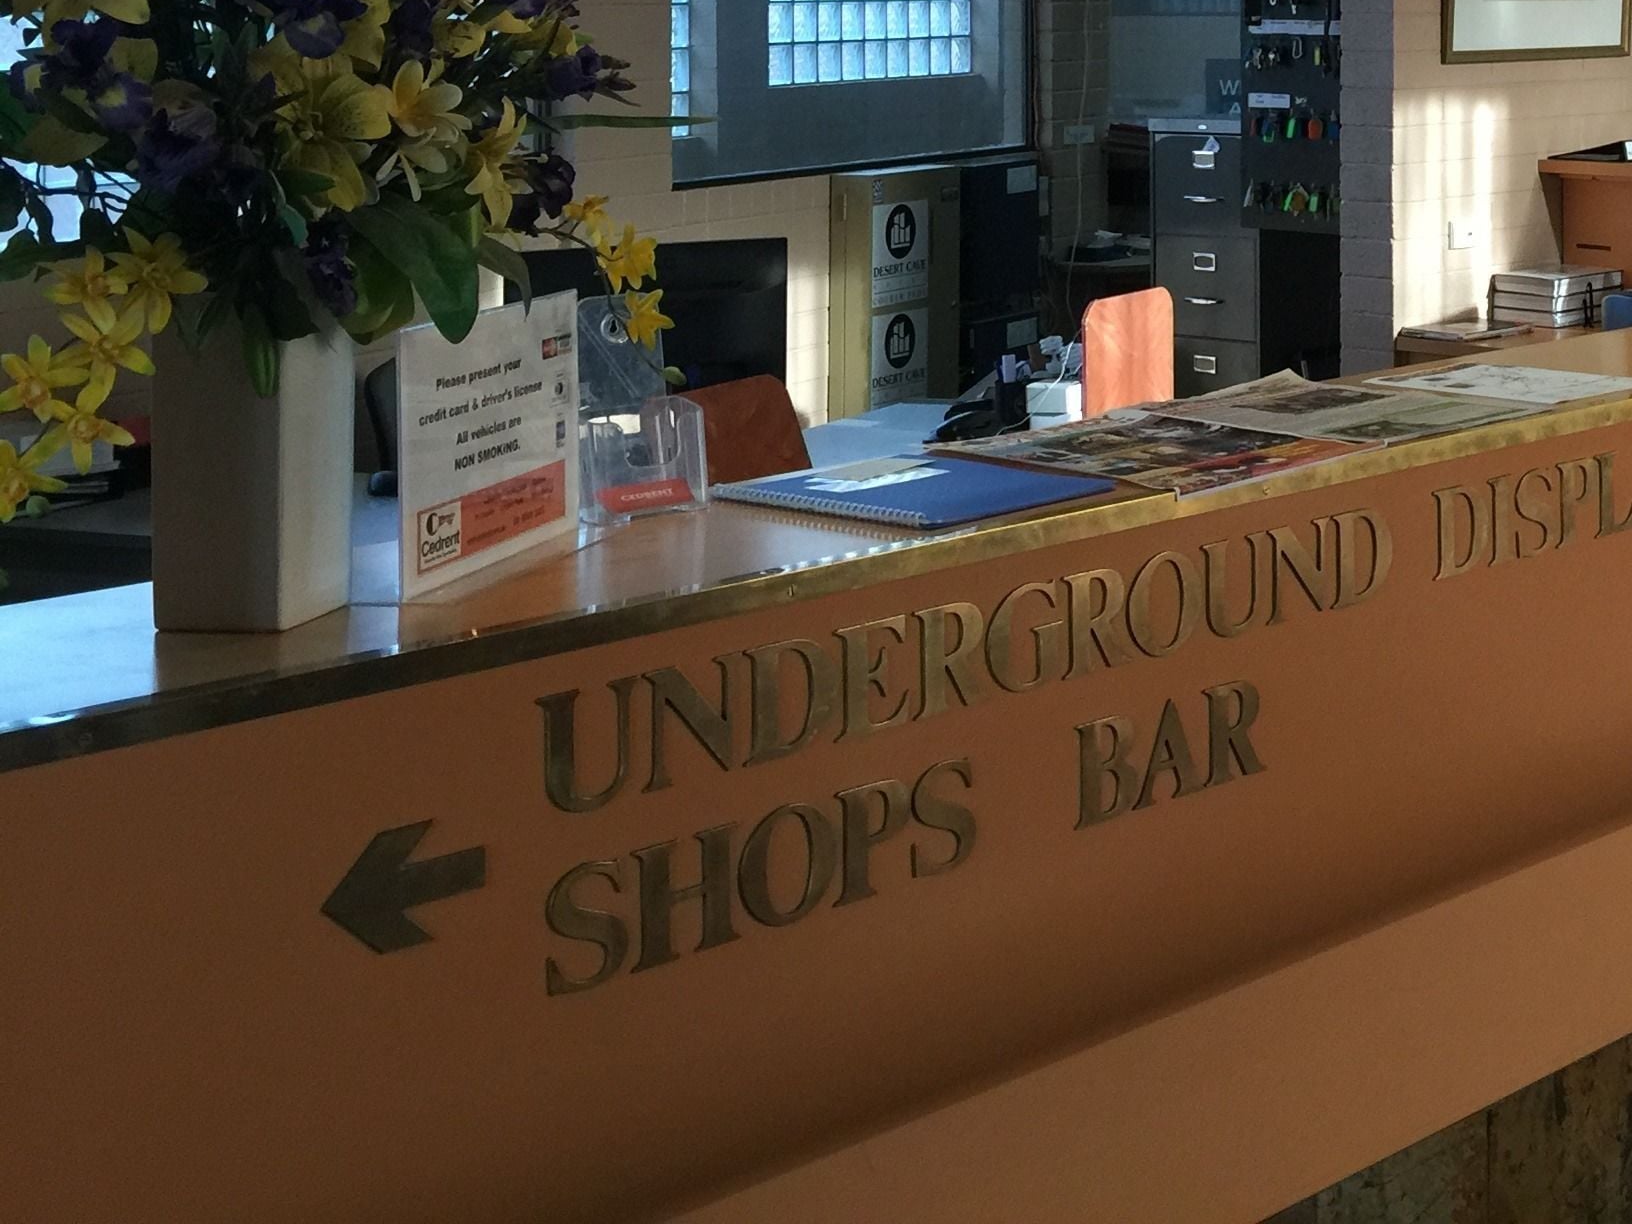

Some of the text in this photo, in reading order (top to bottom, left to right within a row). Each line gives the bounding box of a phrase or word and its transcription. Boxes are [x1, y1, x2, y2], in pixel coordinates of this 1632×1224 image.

[873, 259, 927, 277] DESERT CAVE
[436, 358, 522, 391] Please present your
[872, 373, 903, 388] DESERT
[419, 381, 543, 426] credit card & driver's license
[456, 416, 522, 446] All vehicles are
[454, 439, 521, 472] NON SMOKING.
[421, 530, 461, 558] Cedrent
[535, 504, 1396, 816] UNDERGROUND
[544, 679, 1267, 997] SHOPS BAR
